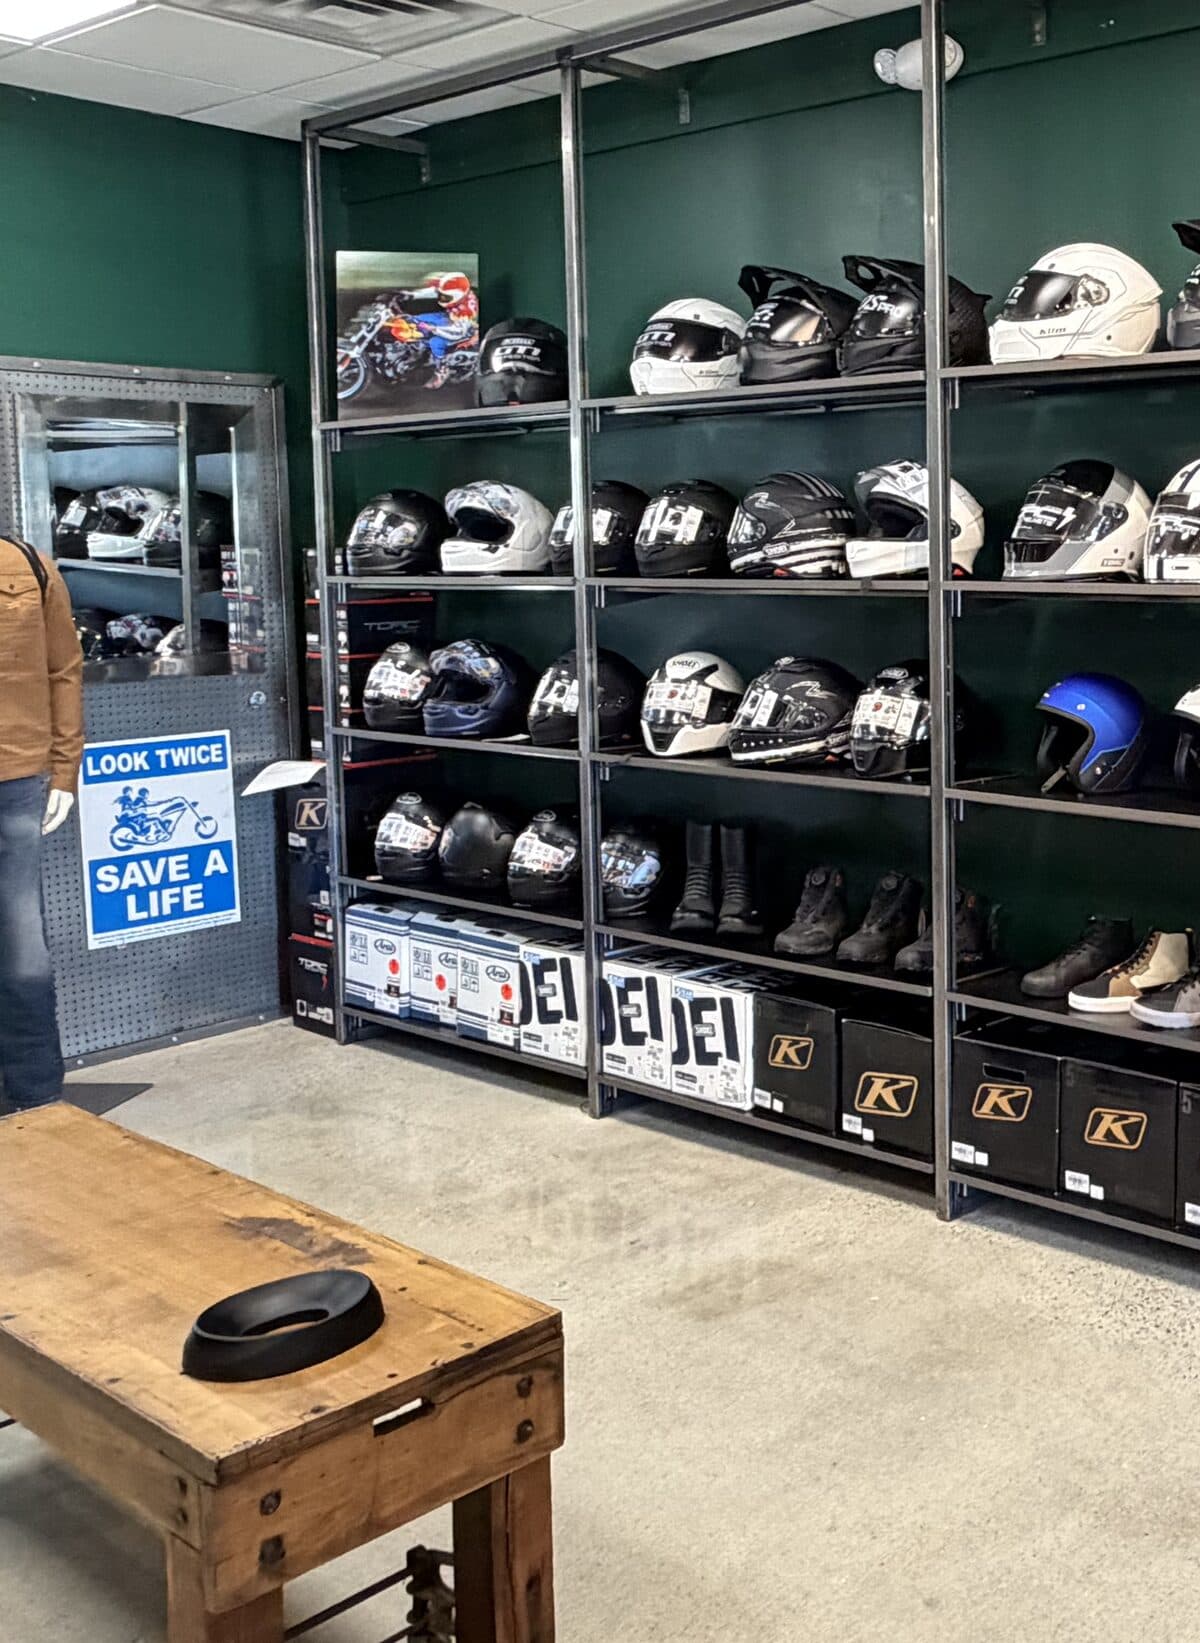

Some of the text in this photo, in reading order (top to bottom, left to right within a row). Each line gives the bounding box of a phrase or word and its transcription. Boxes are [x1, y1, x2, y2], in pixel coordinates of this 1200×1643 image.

[86, 744, 223, 776] LOOK TWICE
[297, 801, 327, 827] K
[96, 848, 229, 893] SAVE A
[126, 883, 205, 922] LIFE
[771, 1038, 811, 1067] K
[857, 1076, 915, 1112] K
[975, 1086, 1028, 1118] K
[1089, 1111, 1143, 1145] K
